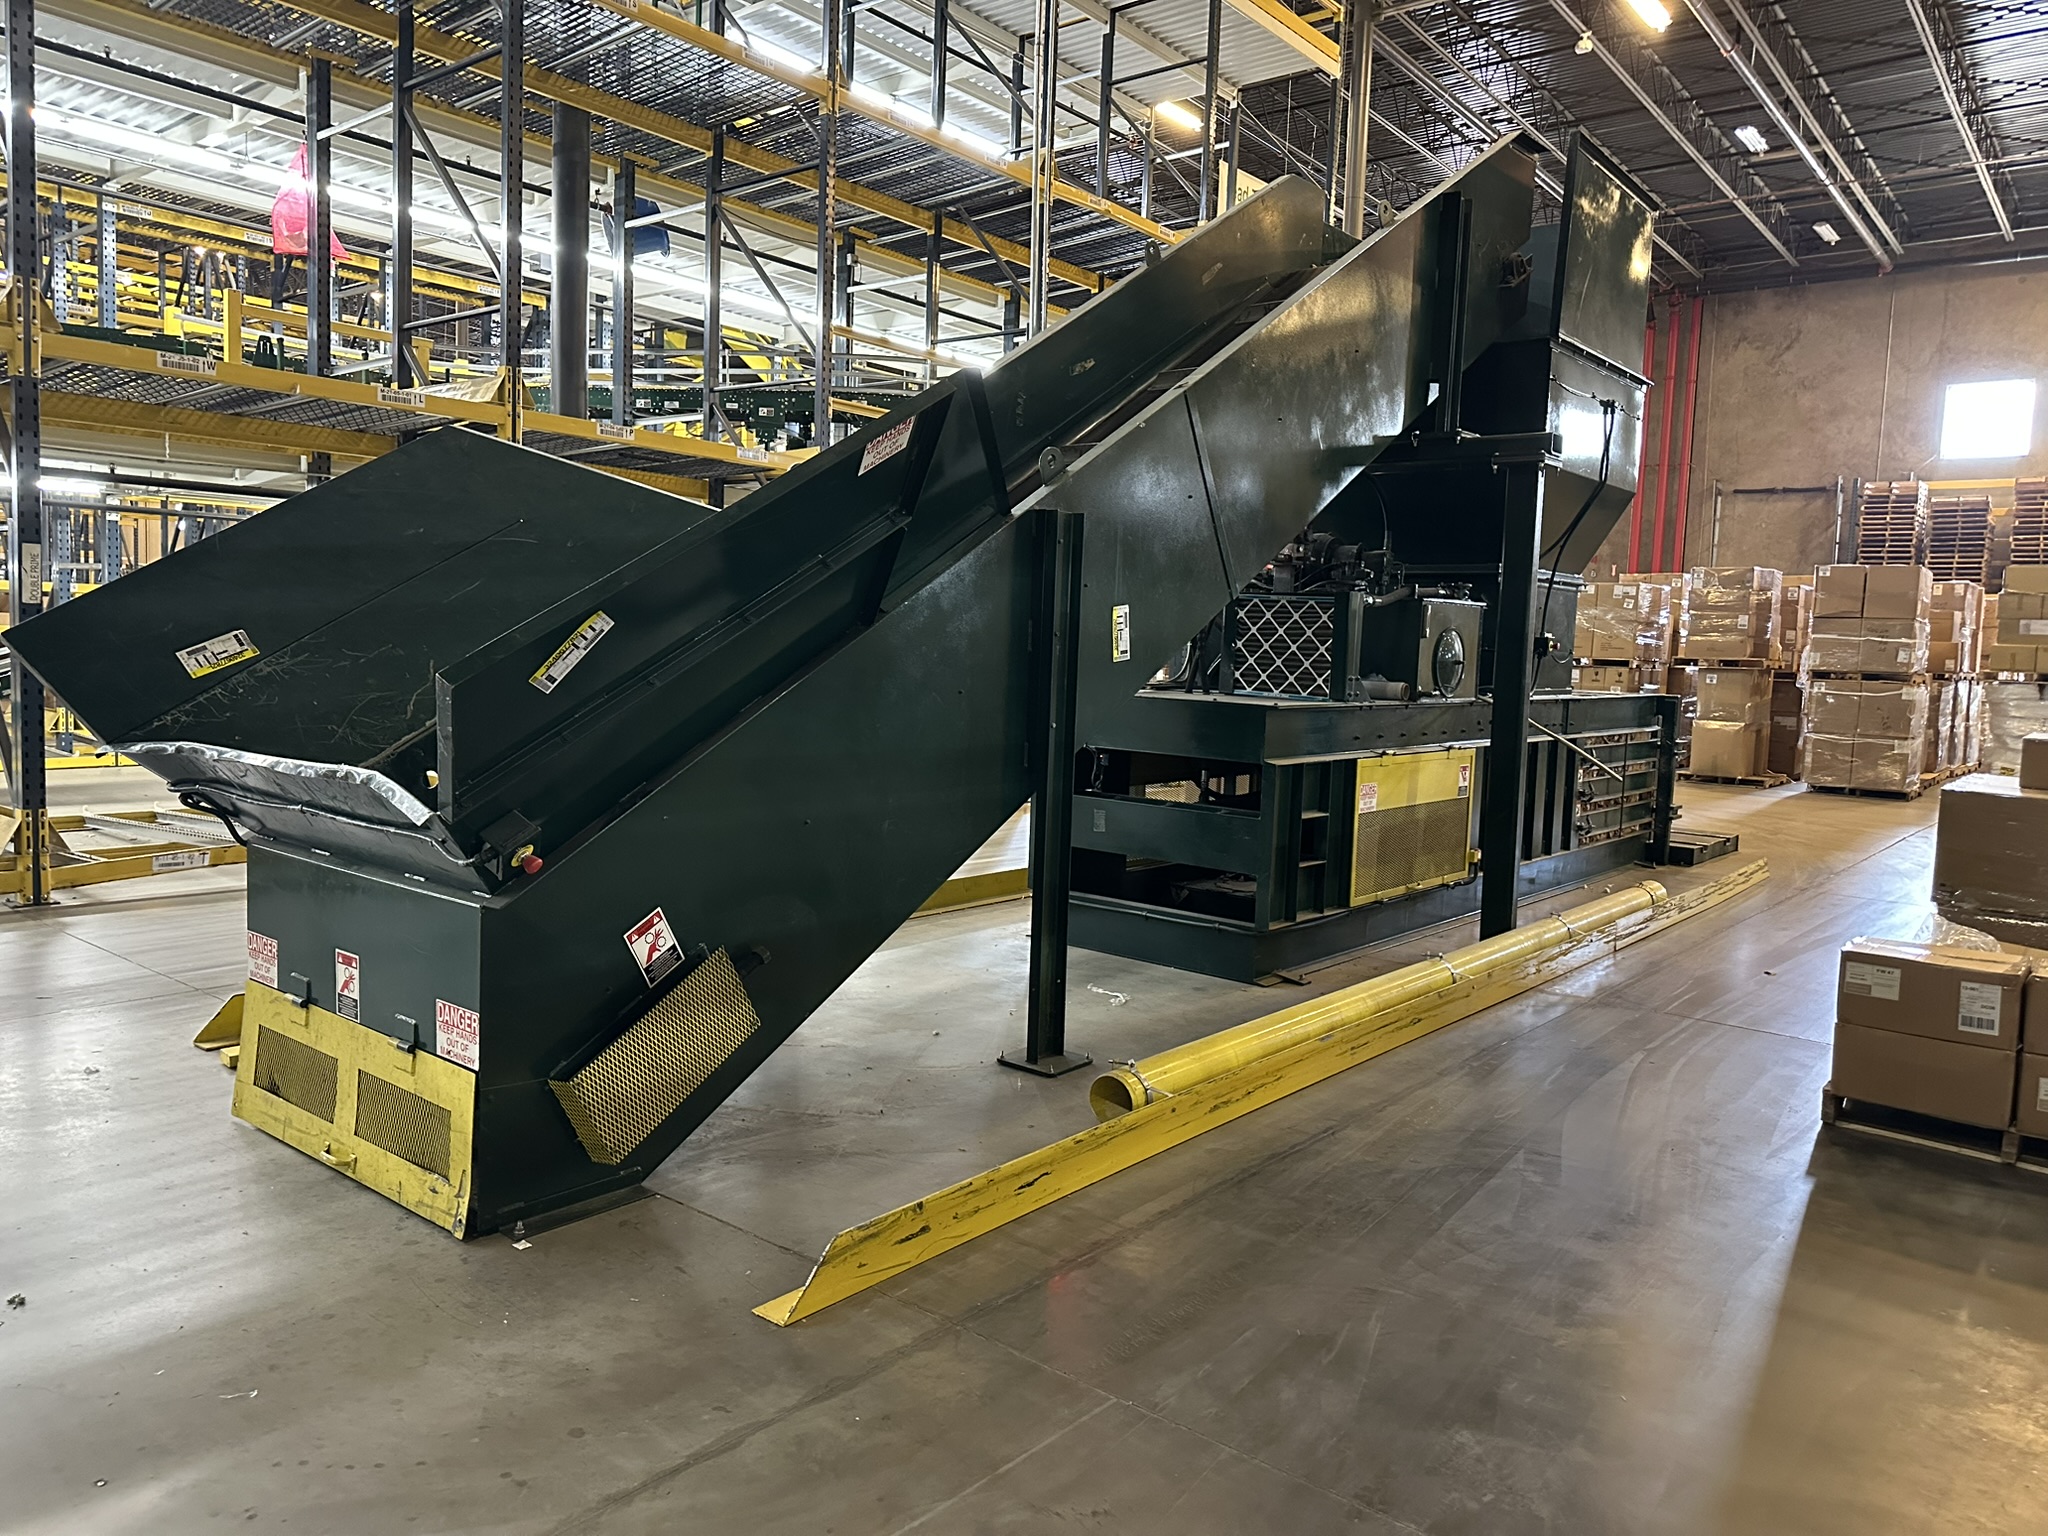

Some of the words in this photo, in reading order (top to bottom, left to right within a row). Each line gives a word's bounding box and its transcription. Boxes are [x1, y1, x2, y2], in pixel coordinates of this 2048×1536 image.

[206, 360, 217, 371] W
[419, 394, 424, 404] L
[873, 445, 886, 458] OUT
[890, 438, 899, 448] OF
[30, 552, 39, 574] PRIME
[29, 574, 39, 601] DOUBLE
[248, 933, 277, 958] DANGER
[250, 969, 275, 985] MACHINERY
[254, 961, 264, 972] OUT
[264, 966, 271, 974] OF
[438, 1002, 478, 1035] DANGER
[438, 1024, 454, 1034] KEEP
[456, 1030, 477, 1046] HANDS
[446, 1037, 459, 1049] OUT
[460, 1042, 469, 1053] OF
[440, 1045, 475, 1067] MACHINERY
